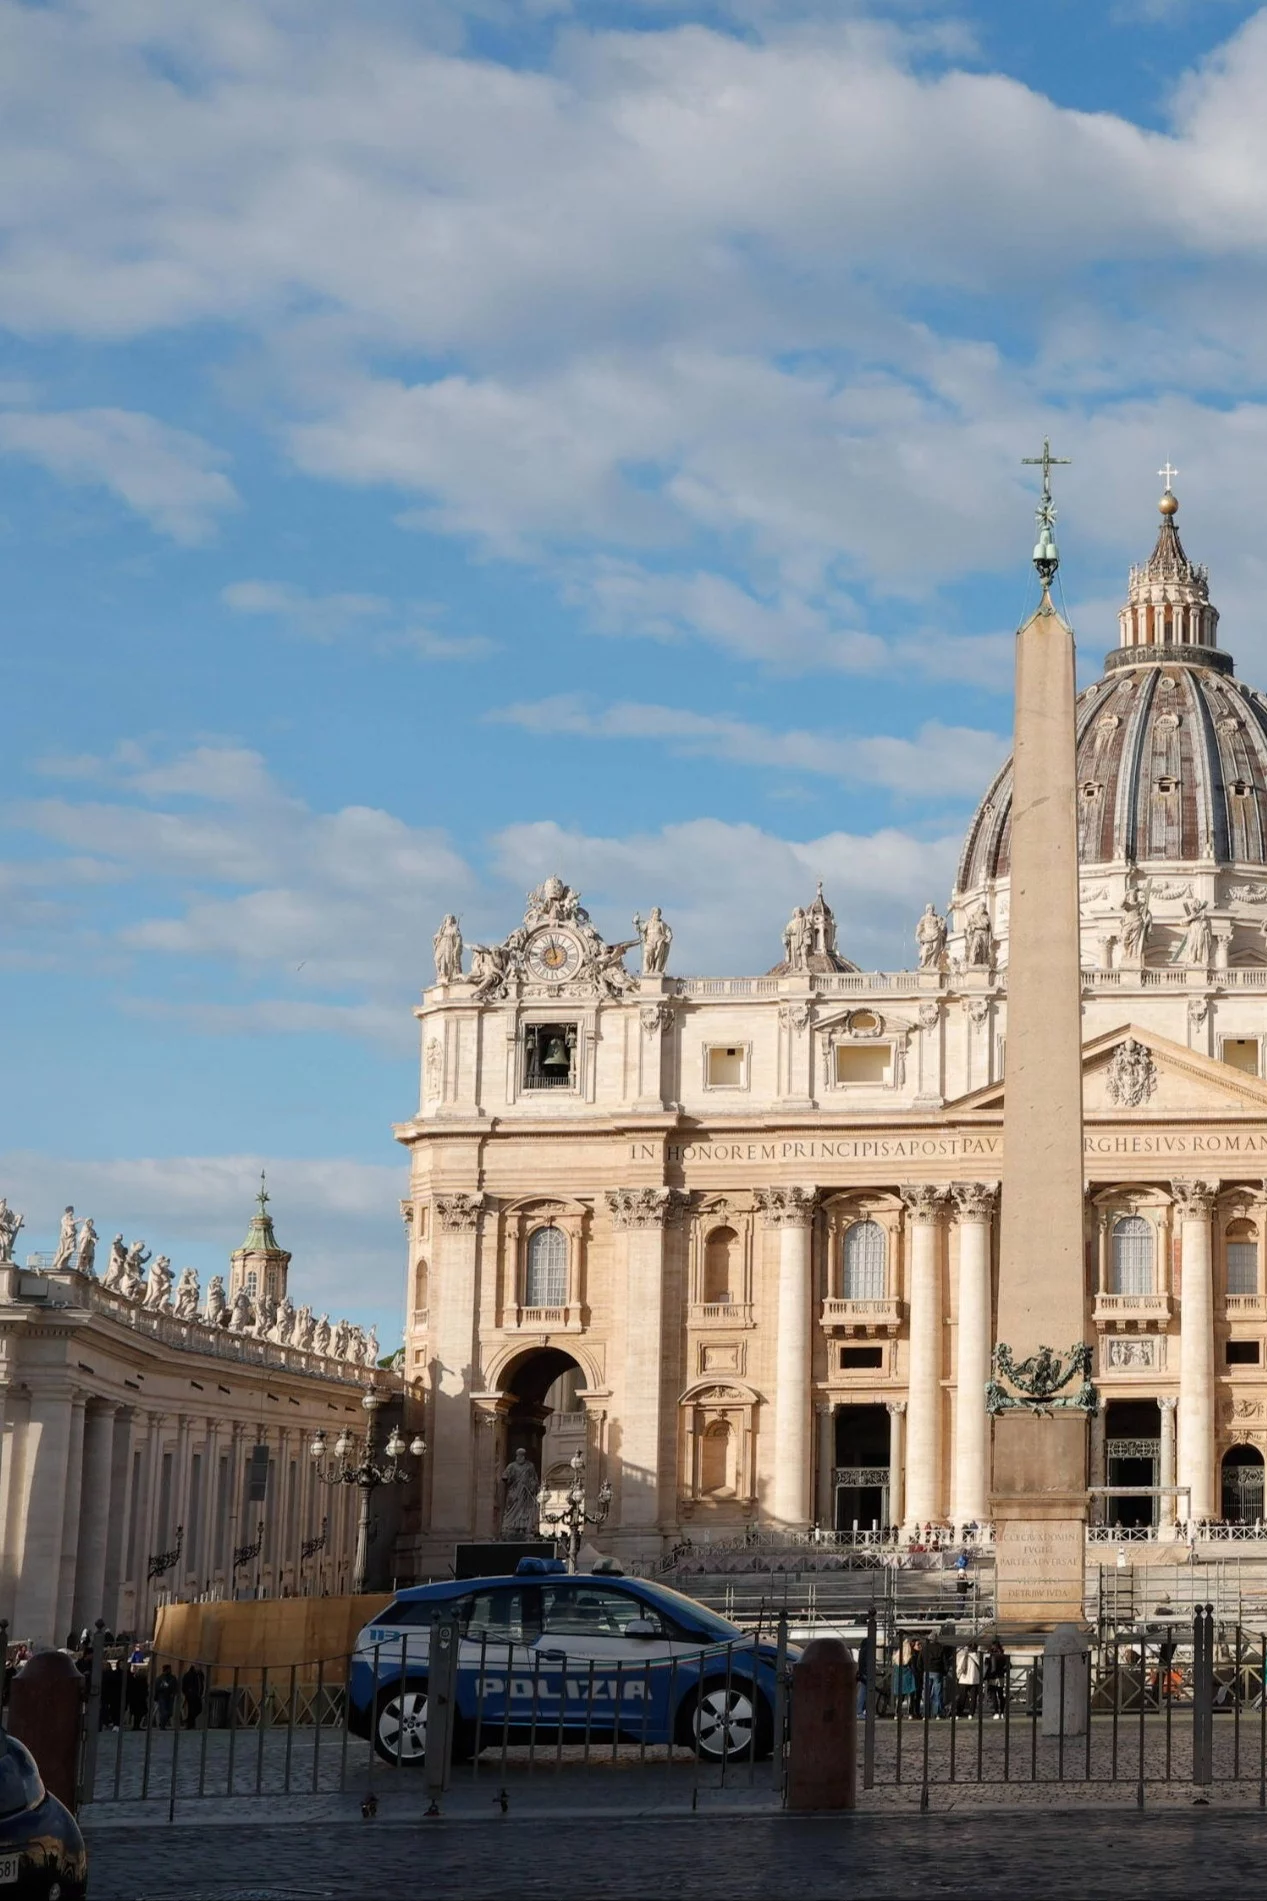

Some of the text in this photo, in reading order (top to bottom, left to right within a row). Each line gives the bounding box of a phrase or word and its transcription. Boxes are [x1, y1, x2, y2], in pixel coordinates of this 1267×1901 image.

[631, 1143, 655, 1160] IN
[667, 1144, 776, 1161] HONOREM
[782, 1141, 889, 1158] PRINCIPIS
[893, 1139, 959, 1157] APOST
[370, 1629, 400, 1643] 113
[475, 1677, 653, 1701] POLIZIA
